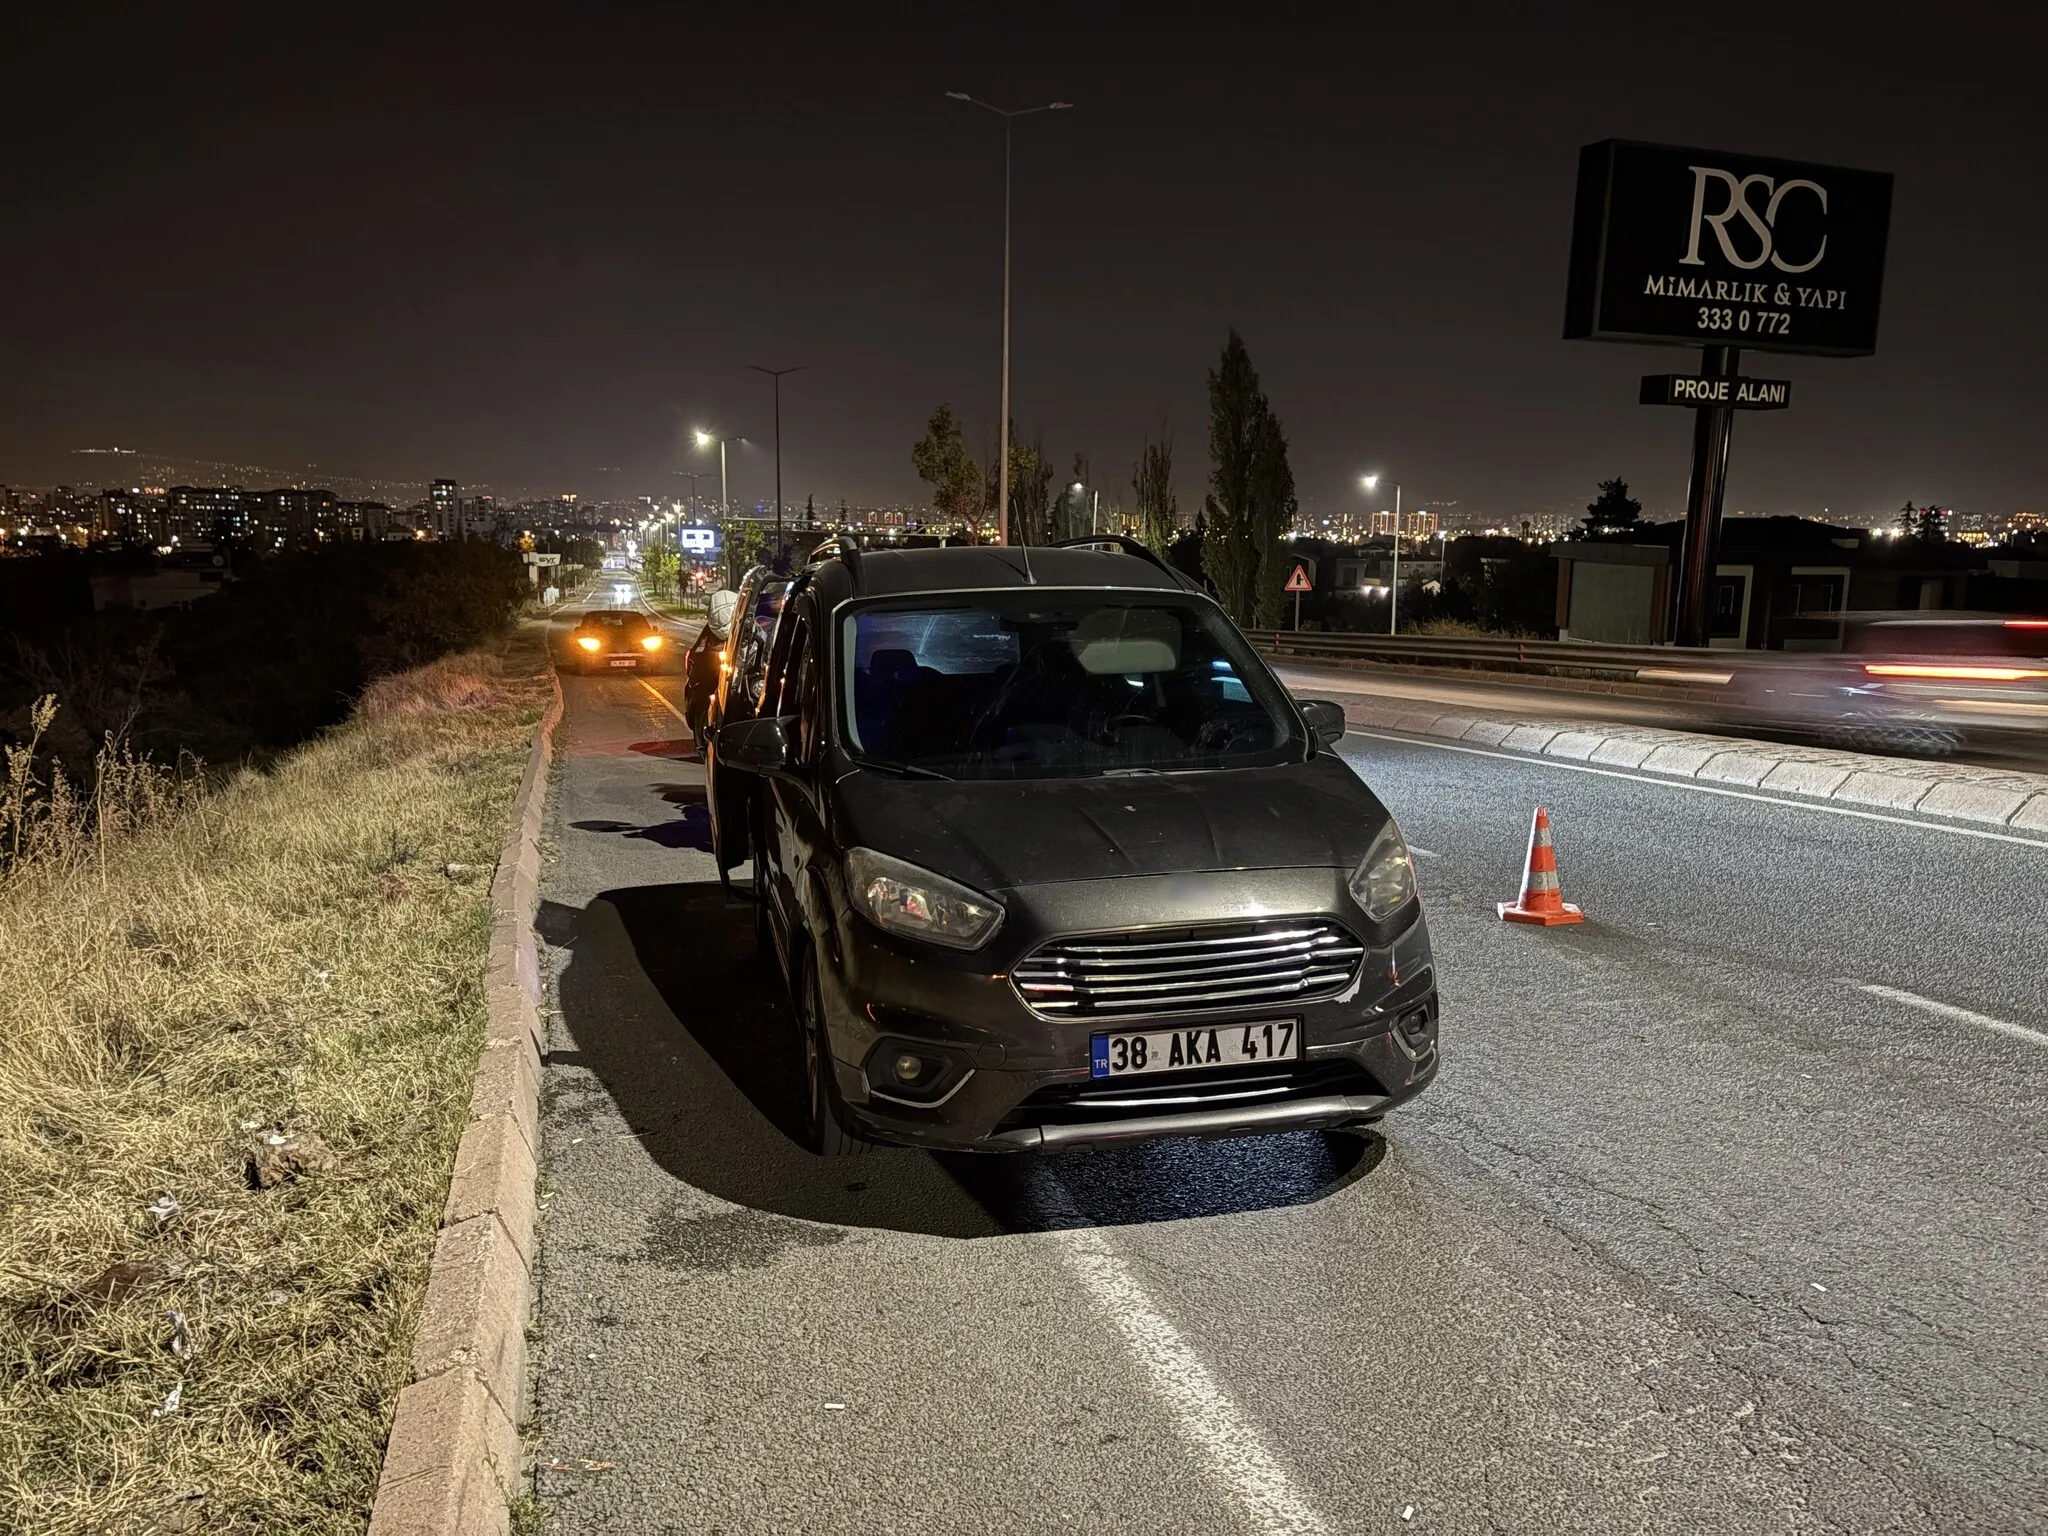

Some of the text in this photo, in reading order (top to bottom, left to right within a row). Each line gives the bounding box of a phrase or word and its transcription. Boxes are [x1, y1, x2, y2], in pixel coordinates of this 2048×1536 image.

[1678, 165, 1828, 273] RSC
[1774, 282, 1792, 306] &
[1796, 287, 1847, 310] YAPI
[1697, 306, 1791, 335] 333 0 772
[1674, 379, 1786, 404] PROJE ALANI
[1111, 1022, 1295, 1072] 38 AKA 417
[1094, 1059, 1108, 1070] TR
